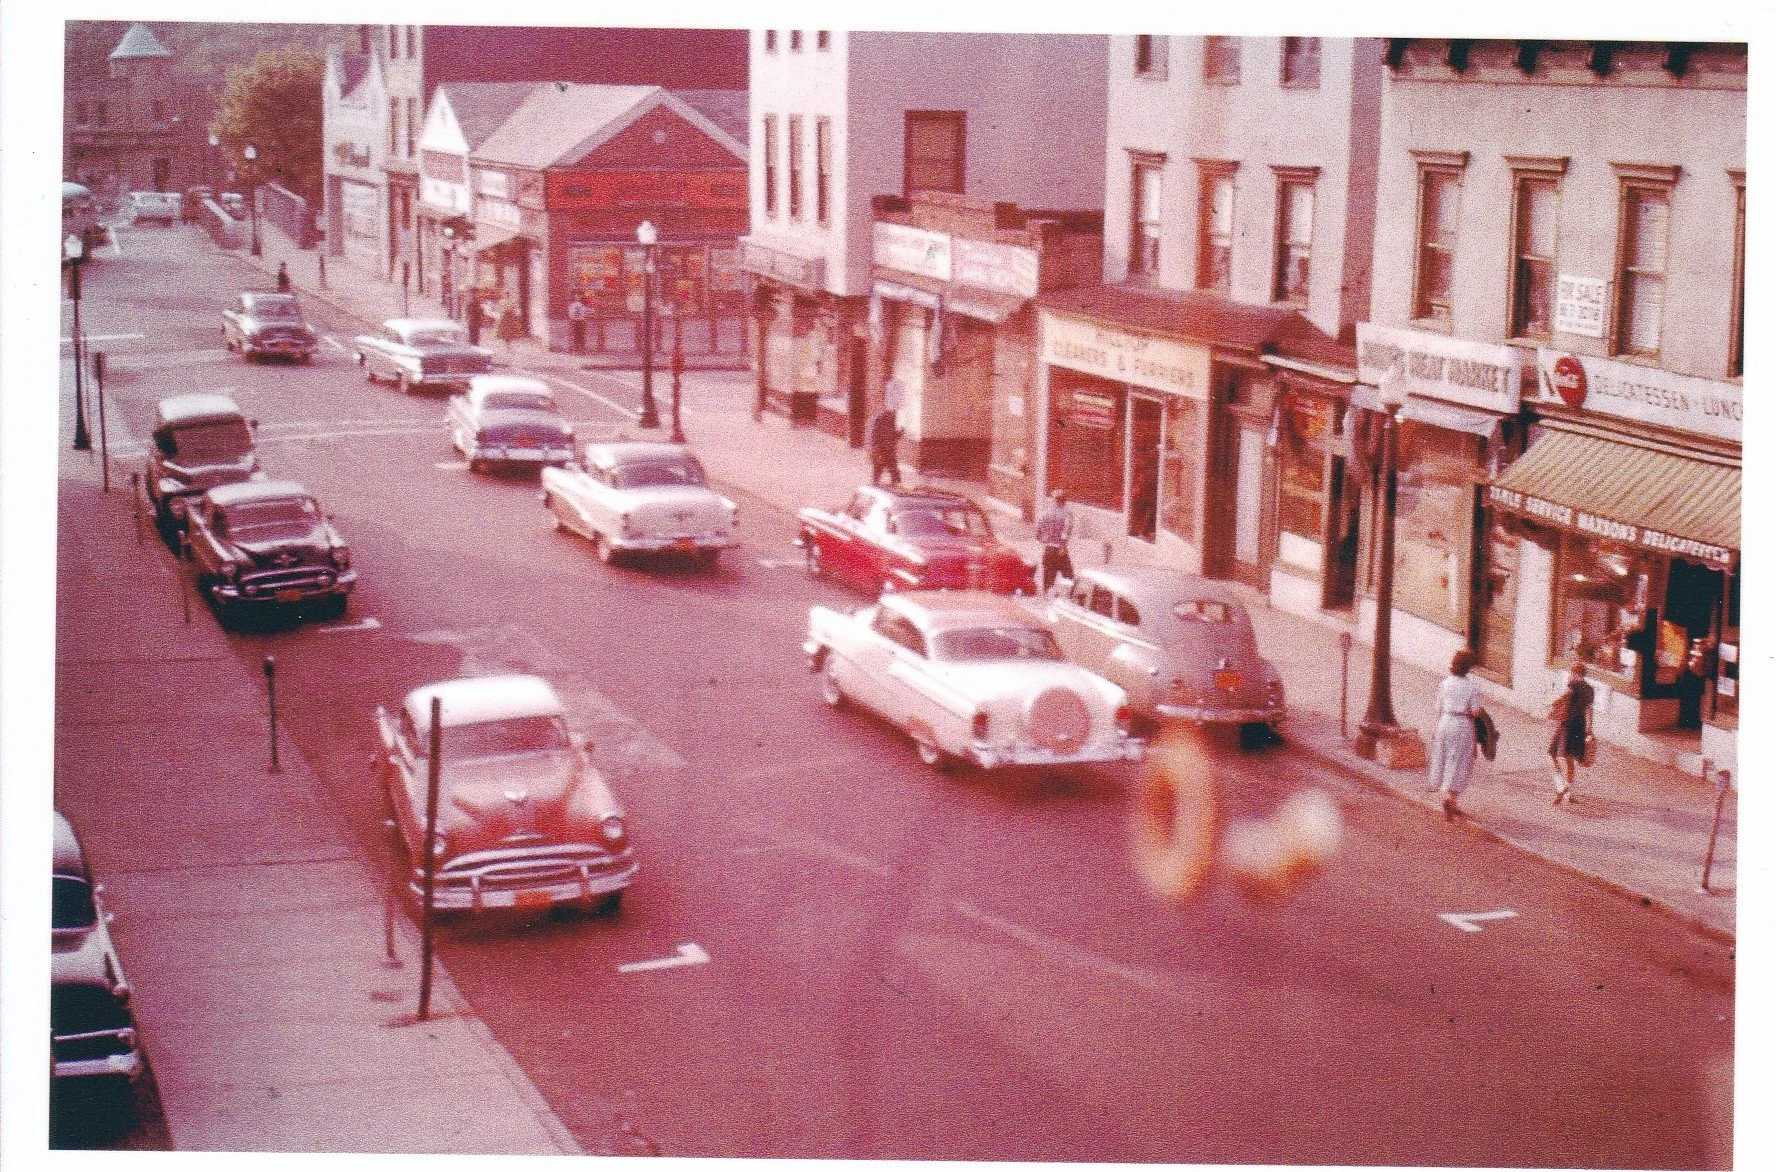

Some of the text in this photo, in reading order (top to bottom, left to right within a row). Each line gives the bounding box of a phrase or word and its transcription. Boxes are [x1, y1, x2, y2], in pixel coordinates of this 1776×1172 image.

[1576, 282, 1602, 304] SALE
[1053, 341, 1107, 366] CLEANERS
[1448, 357, 1511, 393] MARKET
[1593, 373, 1689, 412] DELICATESSEN
[1525, 496, 1572, 524] SERVICE
